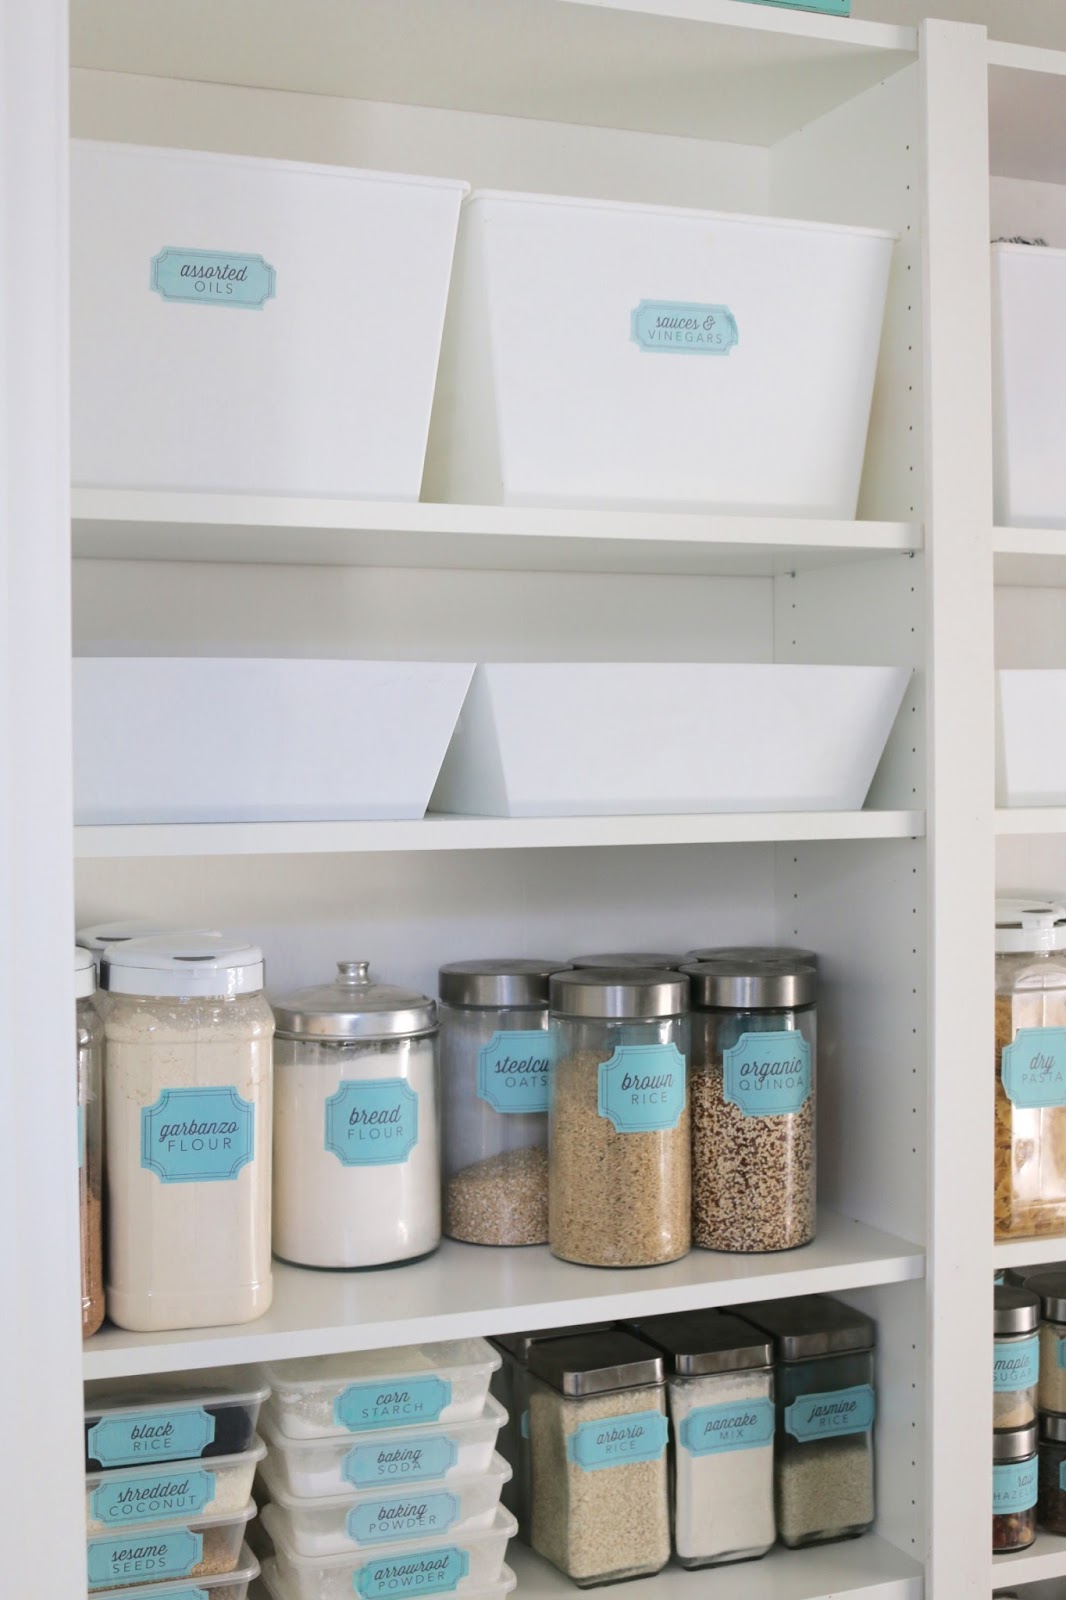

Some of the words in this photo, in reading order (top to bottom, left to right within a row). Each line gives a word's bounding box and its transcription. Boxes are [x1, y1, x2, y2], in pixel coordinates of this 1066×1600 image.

[180, 263, 248, 281] assorted
[194, 280, 233, 294] OILS
[656, 316, 700, 330] sauces
[702, 315, 716, 331] &
[648, 329, 722, 344] VINEGARS
[740, 1056, 803, 1082] organic
[1029, 1052, 1056, 1075] dry
[504, 1075, 548, 1088] OATS
[621, 1072, 674, 1091] brown
[739, 1076, 804, 1092] QUINOA
[1021, 1071, 1064, 1084] PASTA
[631, 1091, 668, 1105] RICE
[348, 1104, 402, 1126] bread
[158, 1119, 240, 1143] garbanzo
[347, 1125, 404, 1140] FLOUR
[167, 1137, 232, 1152] FLOUR
[375, 1391, 411, 1406] corn
[361, 1402, 424, 1419] STARCH
[807, 1399, 858, 1424] jasmine
[703, 1412, 758, 1436] pancake
[819, 1413, 849, 1428] RICE
[130, 1421, 175, 1440] black
[596, 1424, 646, 1446] arborio
[719, 1428, 744, 1440] MIX
[133, 1437, 172, 1452] RICE
[605, 1439, 637, 1455] RICE
[377, 1448, 423, 1464] baking
[377, 1460, 422, 1475] SODA
[116, 1480, 190, 1504] shredded
[108, 1494, 197, 1517] COCONUT
[377, 1503, 429, 1520] baking
[368, 1514, 437, 1534] POWDER
[111, 1544, 169, 1563] sesame
[112, 1557, 167, 1574] SEEDS
[373, 1554, 450, 1581] arrowroot
[378, 1571, 446, 1591] POWDER
